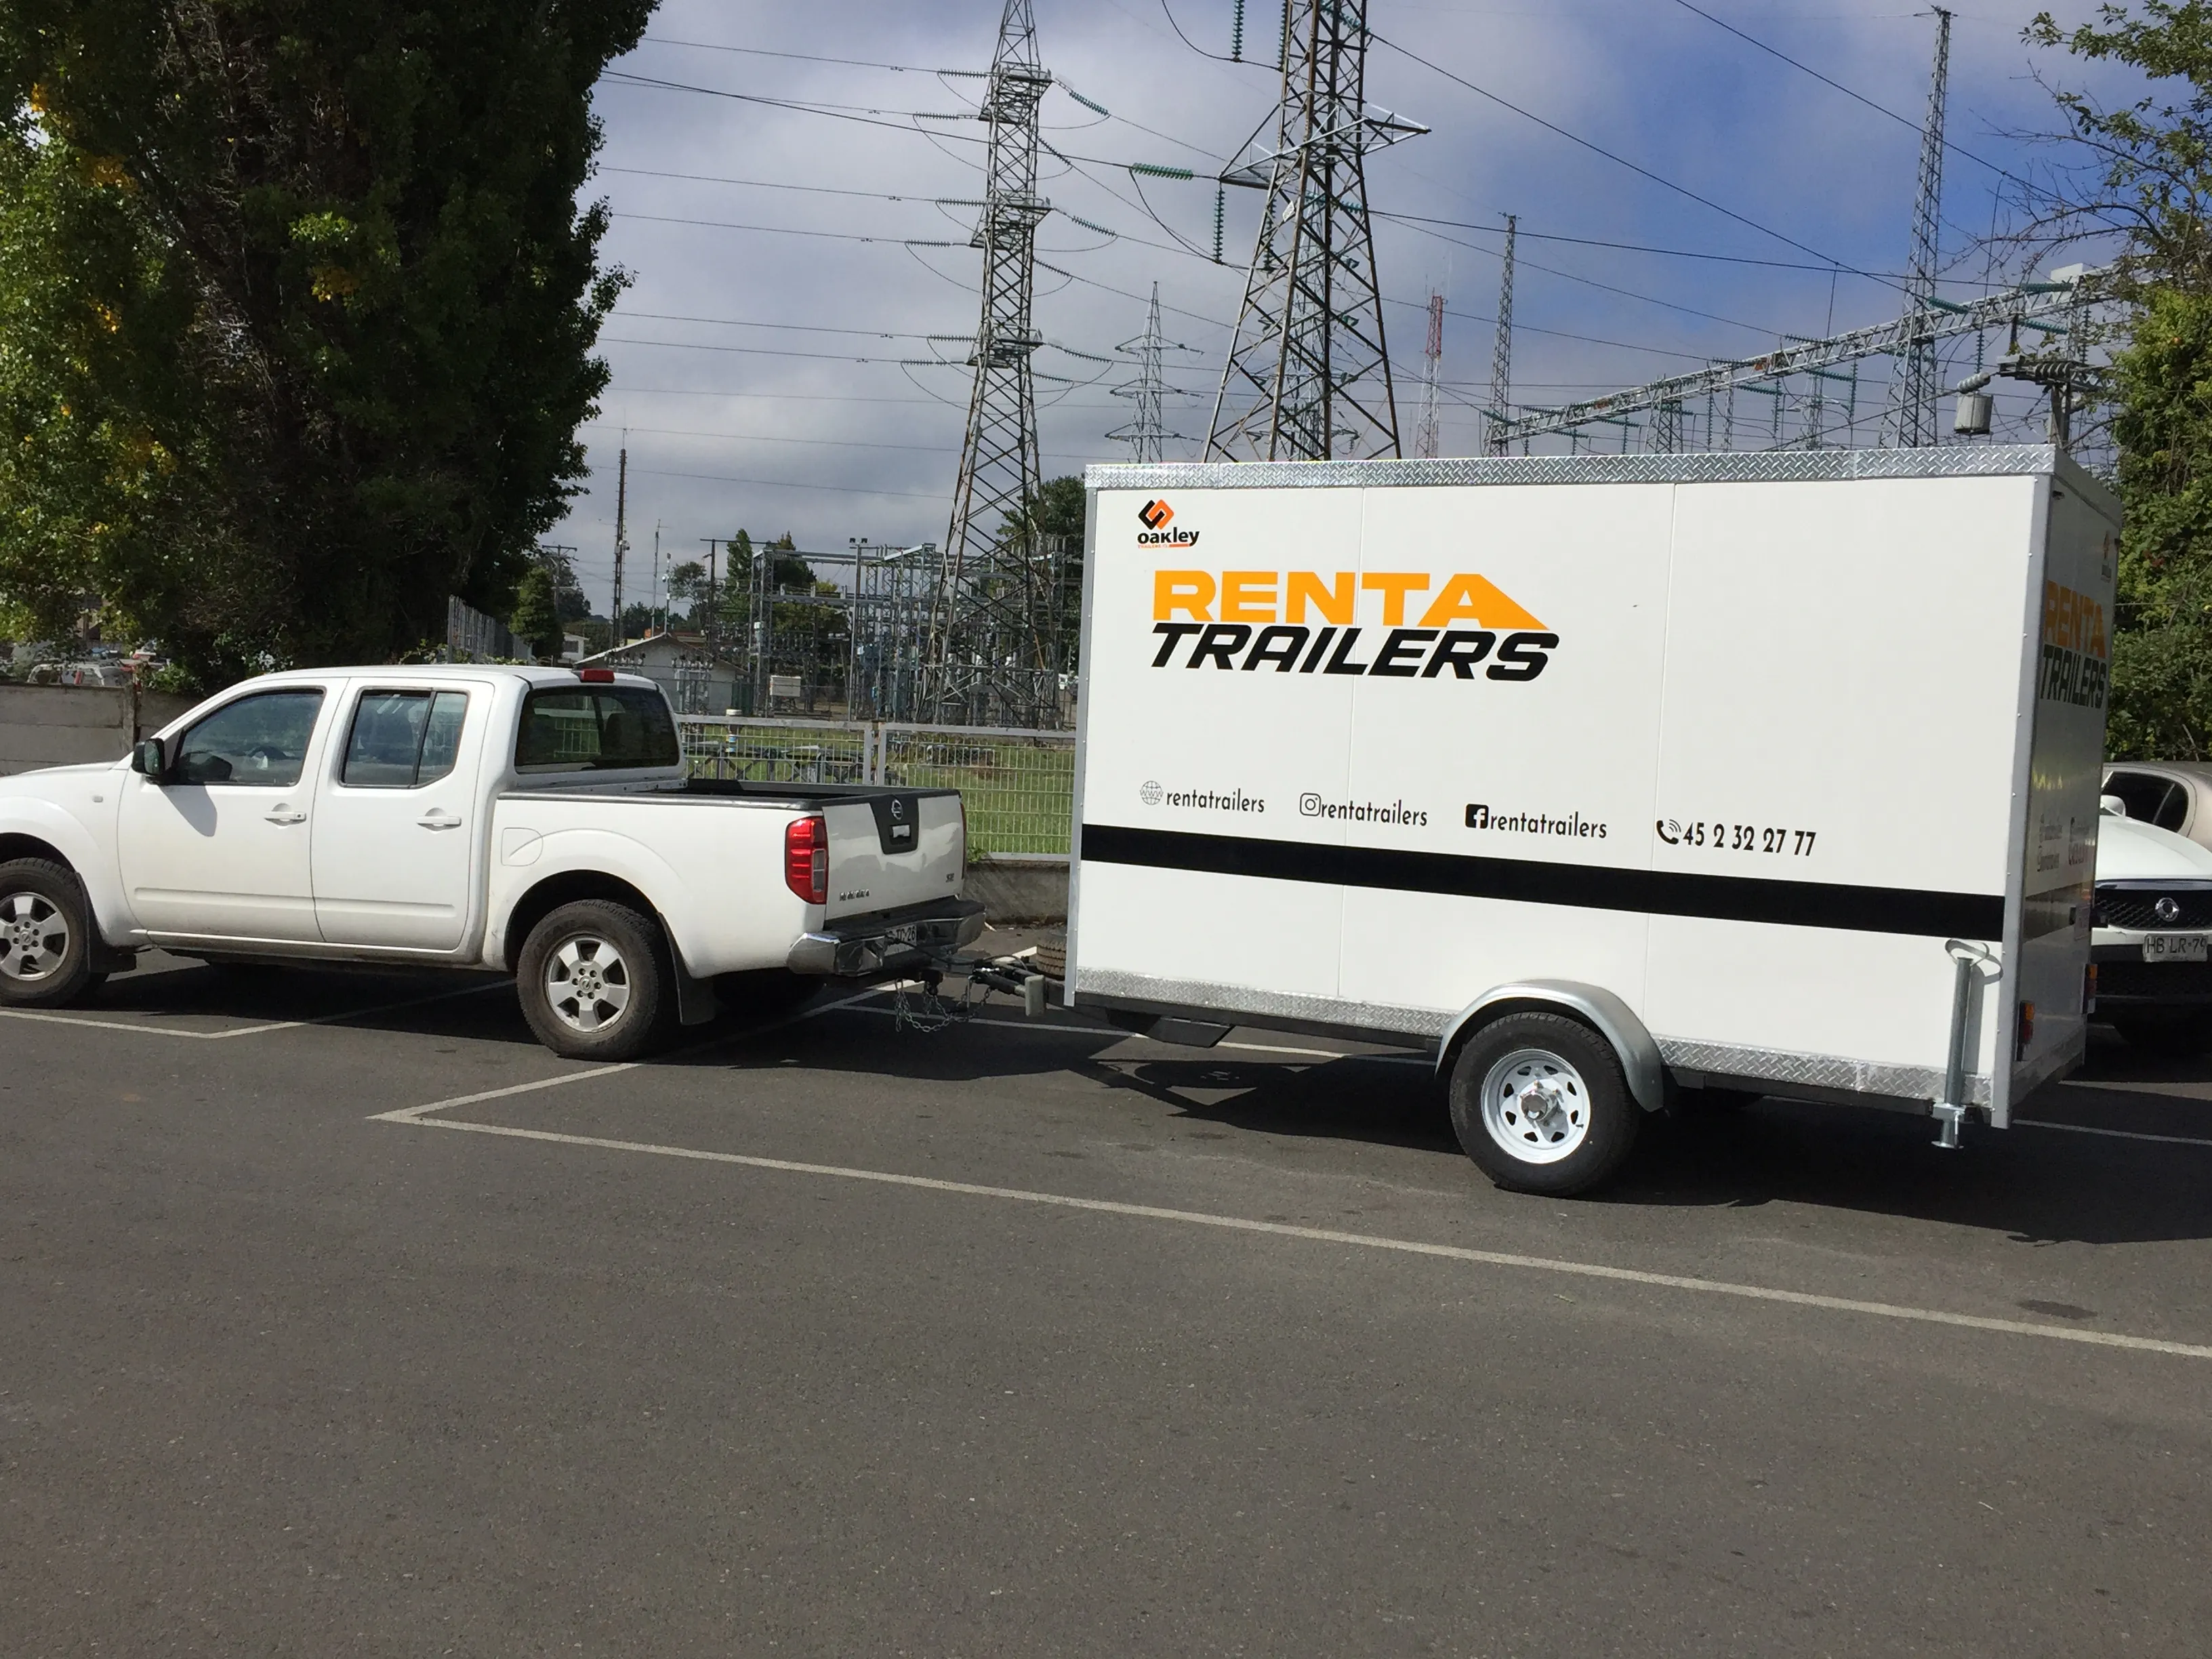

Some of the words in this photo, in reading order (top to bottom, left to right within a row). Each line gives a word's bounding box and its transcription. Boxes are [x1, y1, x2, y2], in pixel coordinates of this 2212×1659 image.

[1153, 570, 1550, 630] RENTA
[2043, 579, 2106, 659] RENTA
[1151, 622, 1559, 682] TRAILERS
[2040, 644, 2107, 709] TRAILERS
[1166, 787, 1265, 813] rentatrailers
[1322, 799, 1427, 827] rentatrailers
[1490, 811, 1607, 839] rentatrailers
[1683, 822, 1704, 846] 45
[1713, 823, 1725, 848] 2
[1732, 825, 1755, 851] 32
[1763, 827, 1787, 854] 27
[1794, 830, 1817, 857] 77
[2147, 937, 2165, 954] HB
